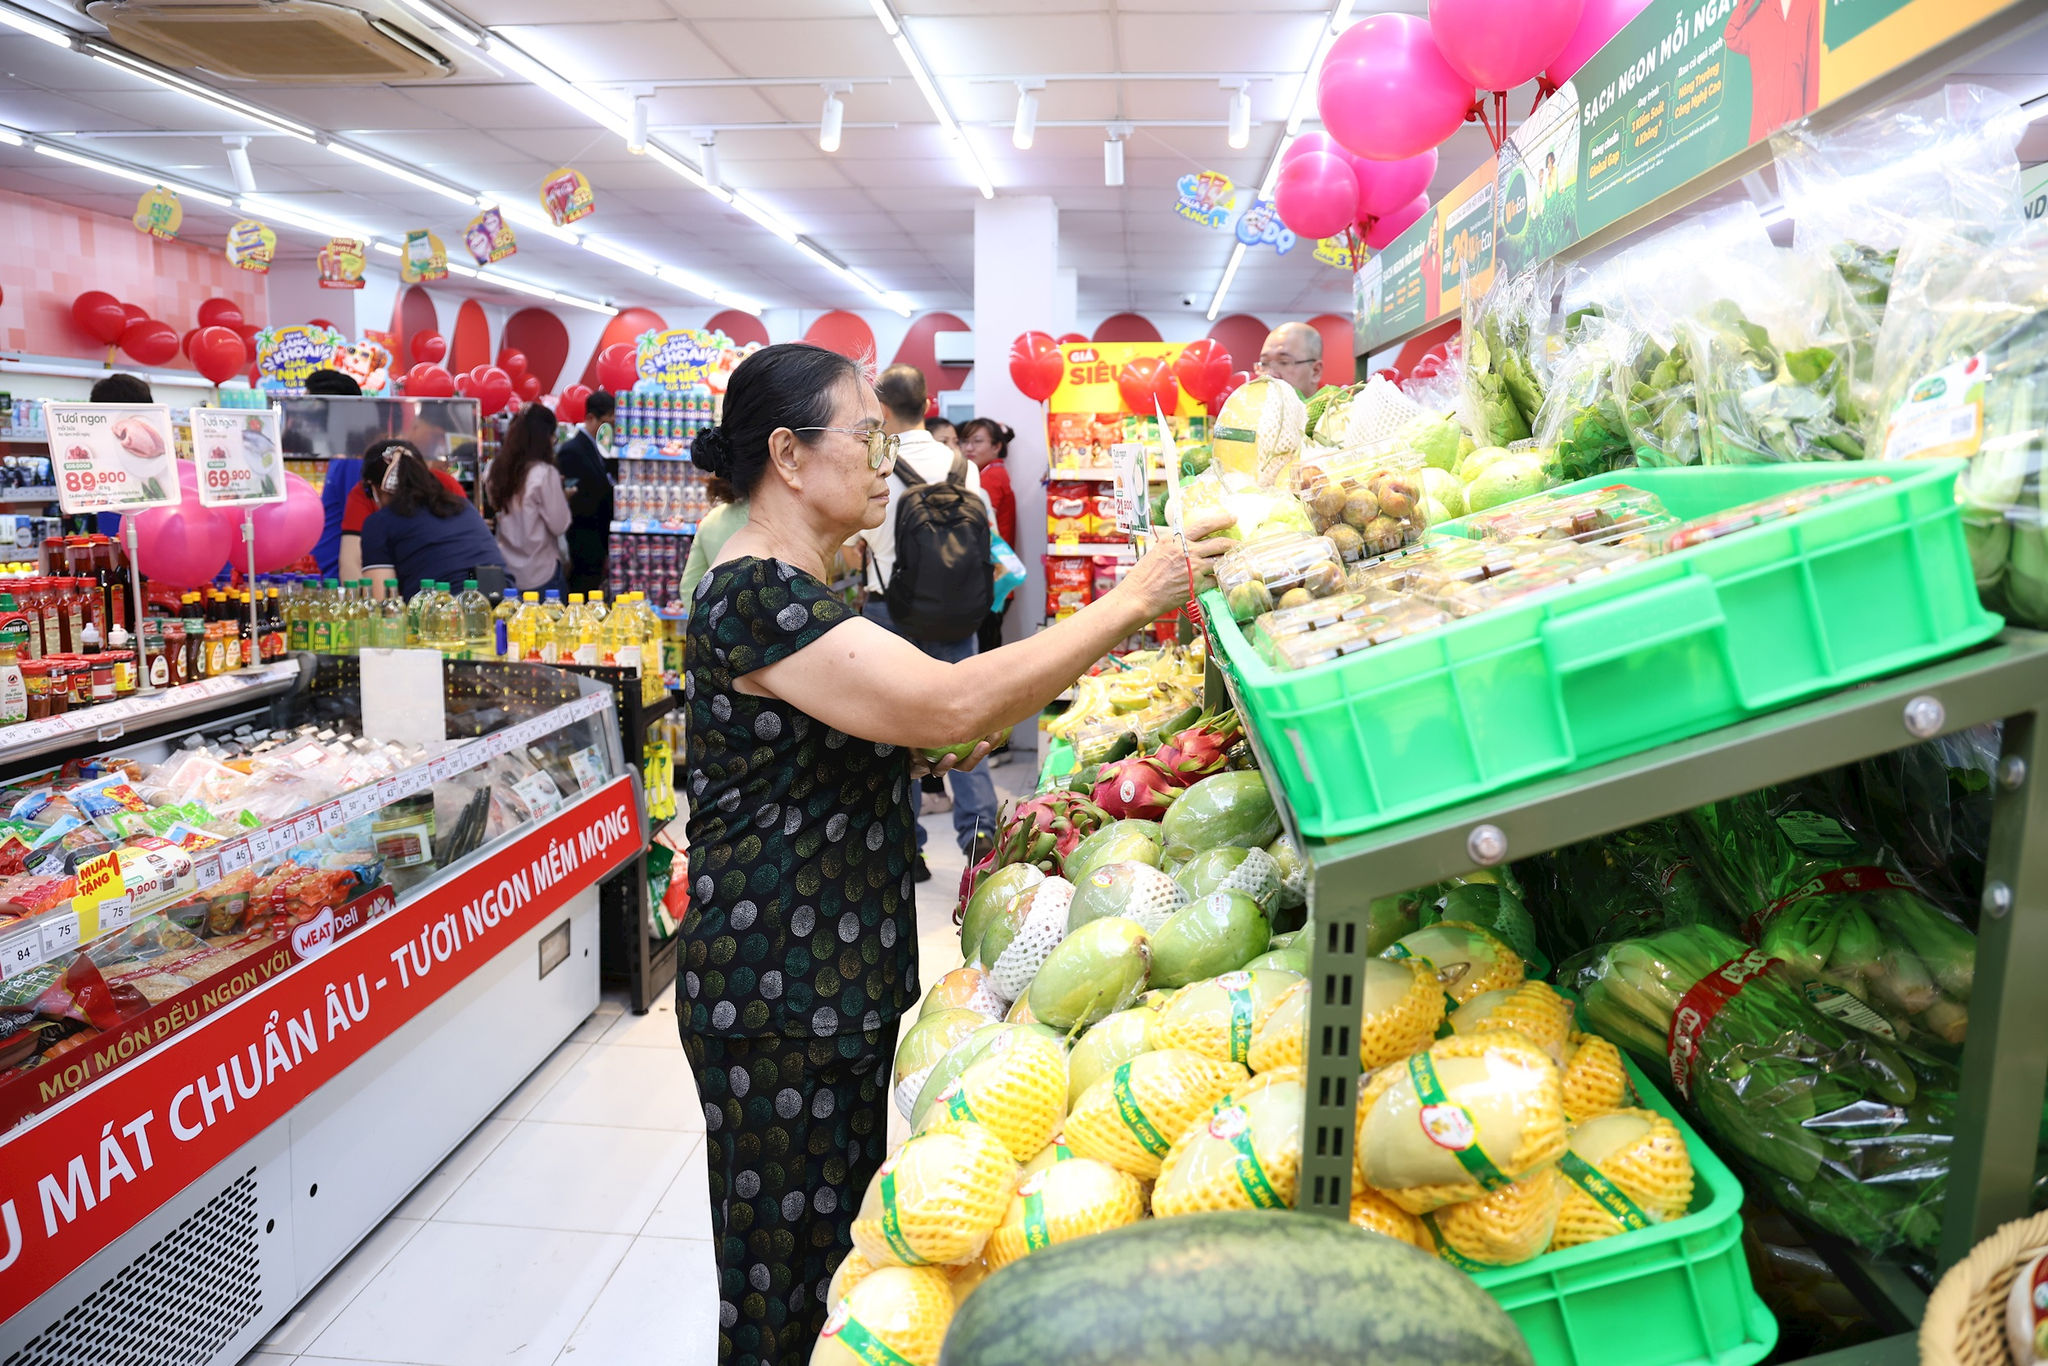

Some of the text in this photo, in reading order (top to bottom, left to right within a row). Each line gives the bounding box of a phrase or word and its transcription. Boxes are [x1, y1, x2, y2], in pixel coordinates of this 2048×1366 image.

[1584, 81, 1616, 127] SẠCH
[1618, 47, 1656, 99] NGON
[1660, 9, 1690, 65] MỖI
[1070, 347, 1096, 362] GIÁ
[55, 412, 107, 426] Tươi ngon
[330, 810, 338, 819] 45
[306, 820, 315, 831] 39
[283, 829, 291, 839] 47
[257, 841, 266, 851] 53
[236, 850, 246, 860] 46
[80, 859, 107, 880] MUA
[107, 852, 120, 876] 1
[205, 866, 215, 878] 48
[79, 872, 110, 896] TẶNG
[113, 906, 124, 918] 75
[58, 924, 71, 937] 75
[17, 947, 30, 960] 84
[38, 1058, 91, 1103] MỌI
[94, 1024, 152, 1073] MÓN
[153, 1000, 200, 1044] ĐỀU
[201, 968, 258, 1013] NGON
[261, 948, 292, 983] VỚI
[300, 922, 332, 951] MEAT
[334, 905, 359, 933] Deli
[36, 1110, 155, 1239] MÁT
[168, 1010, 320, 1142] CHUẨN
[324, 973, 371, 1043] ÂU
[390, 912, 462, 989] TƯƠI
[461, 868, 531, 944] NGON
[530, 838, 579, 896] MỀM
[577, 804, 631, 865] MỌNG
